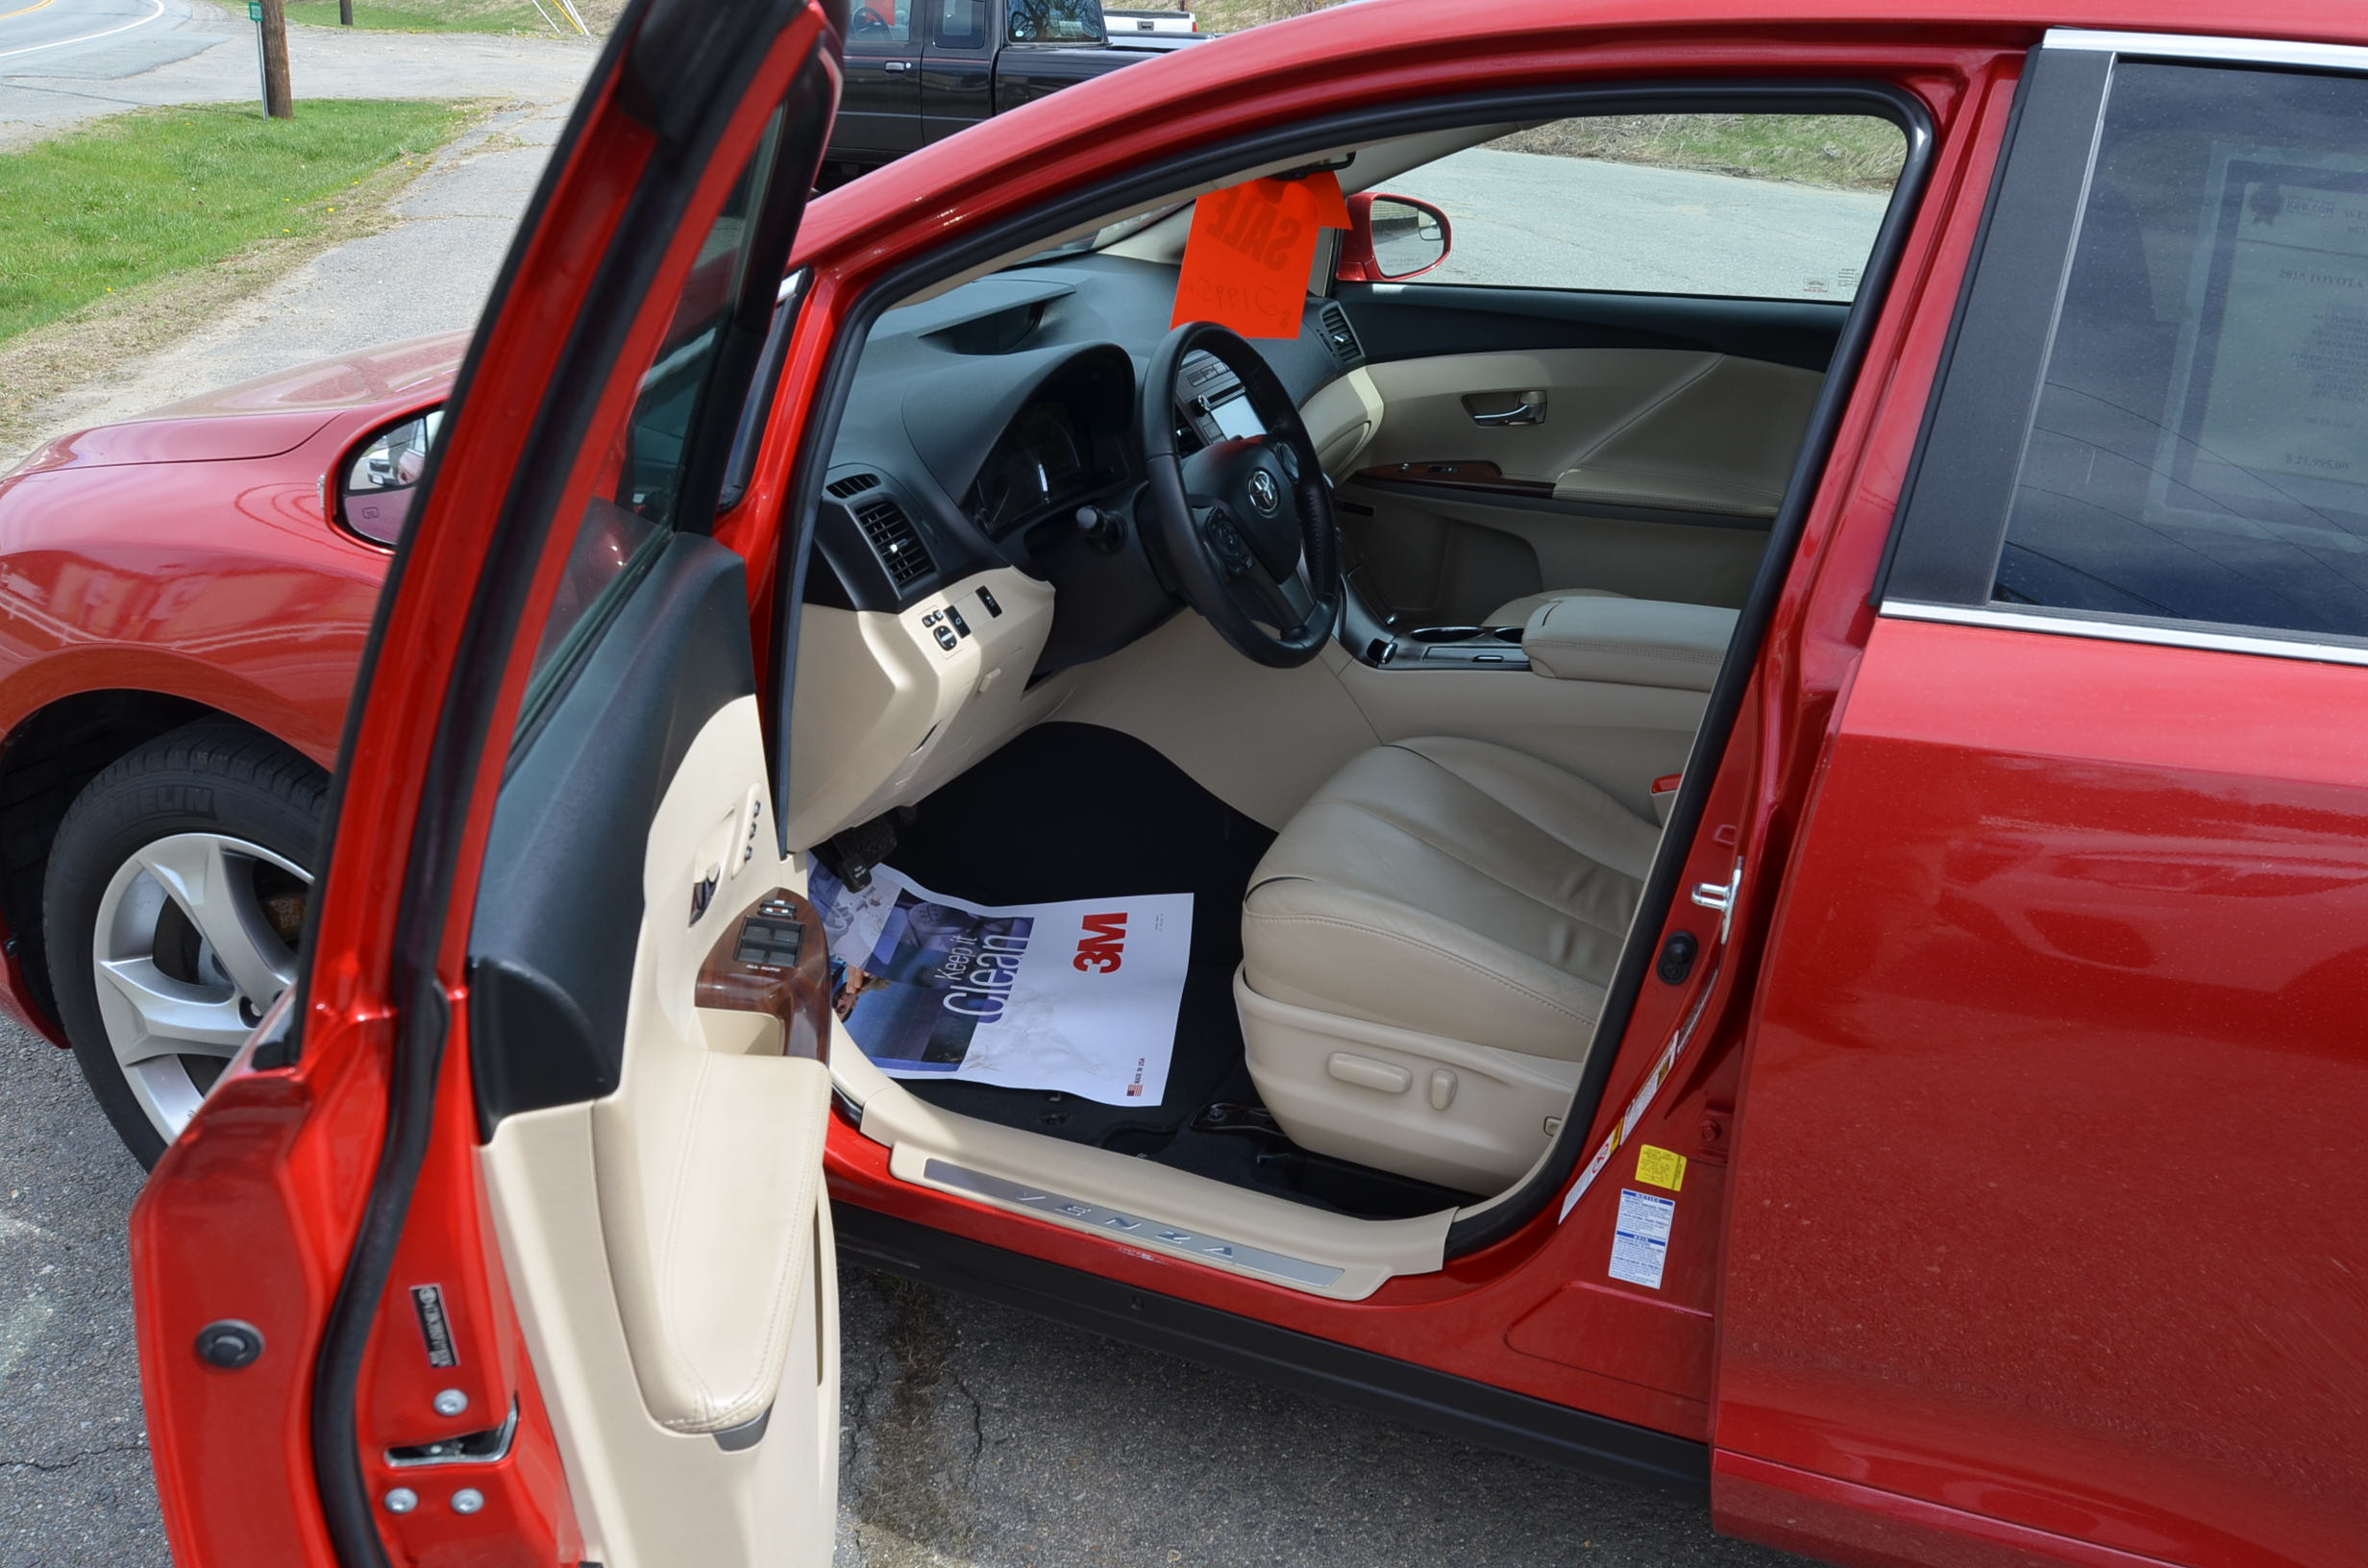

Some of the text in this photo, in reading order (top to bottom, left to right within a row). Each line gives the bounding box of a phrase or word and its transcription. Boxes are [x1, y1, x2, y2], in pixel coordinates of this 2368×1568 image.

[933, 934, 977, 980] Keep it
[1073, 912, 1129, 974] 3M
[943, 934, 1031, 1016] Clean
